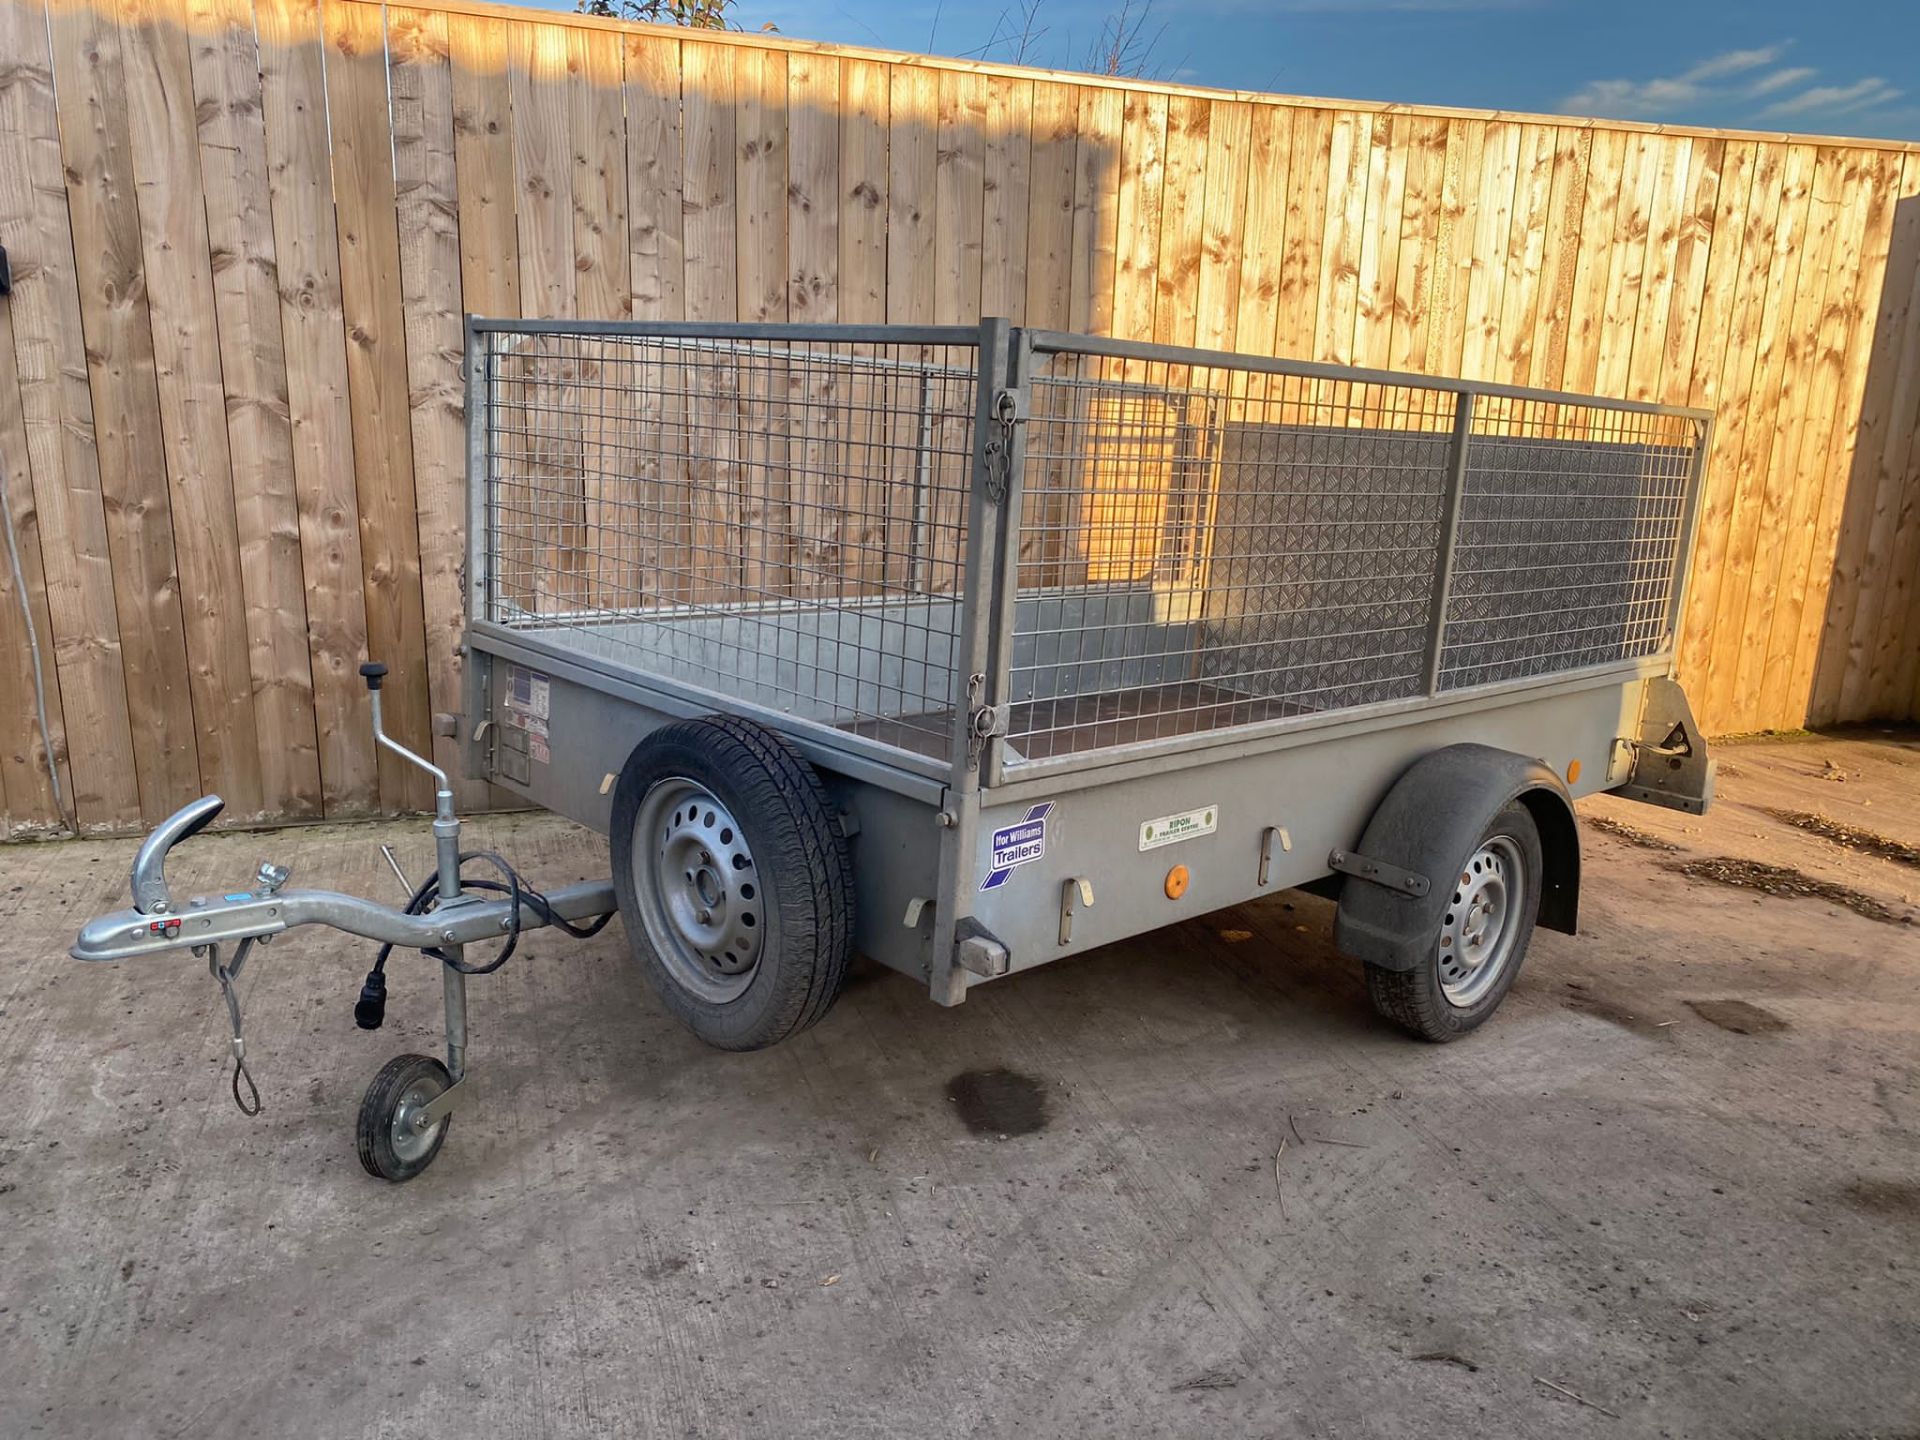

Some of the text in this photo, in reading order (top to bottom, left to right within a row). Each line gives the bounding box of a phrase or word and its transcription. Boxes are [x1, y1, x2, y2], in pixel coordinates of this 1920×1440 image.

[1169, 817, 1191, 828] RIPON
[995, 826, 1042, 847] Ifor Williams
[995, 843, 1041, 864] Trailers
